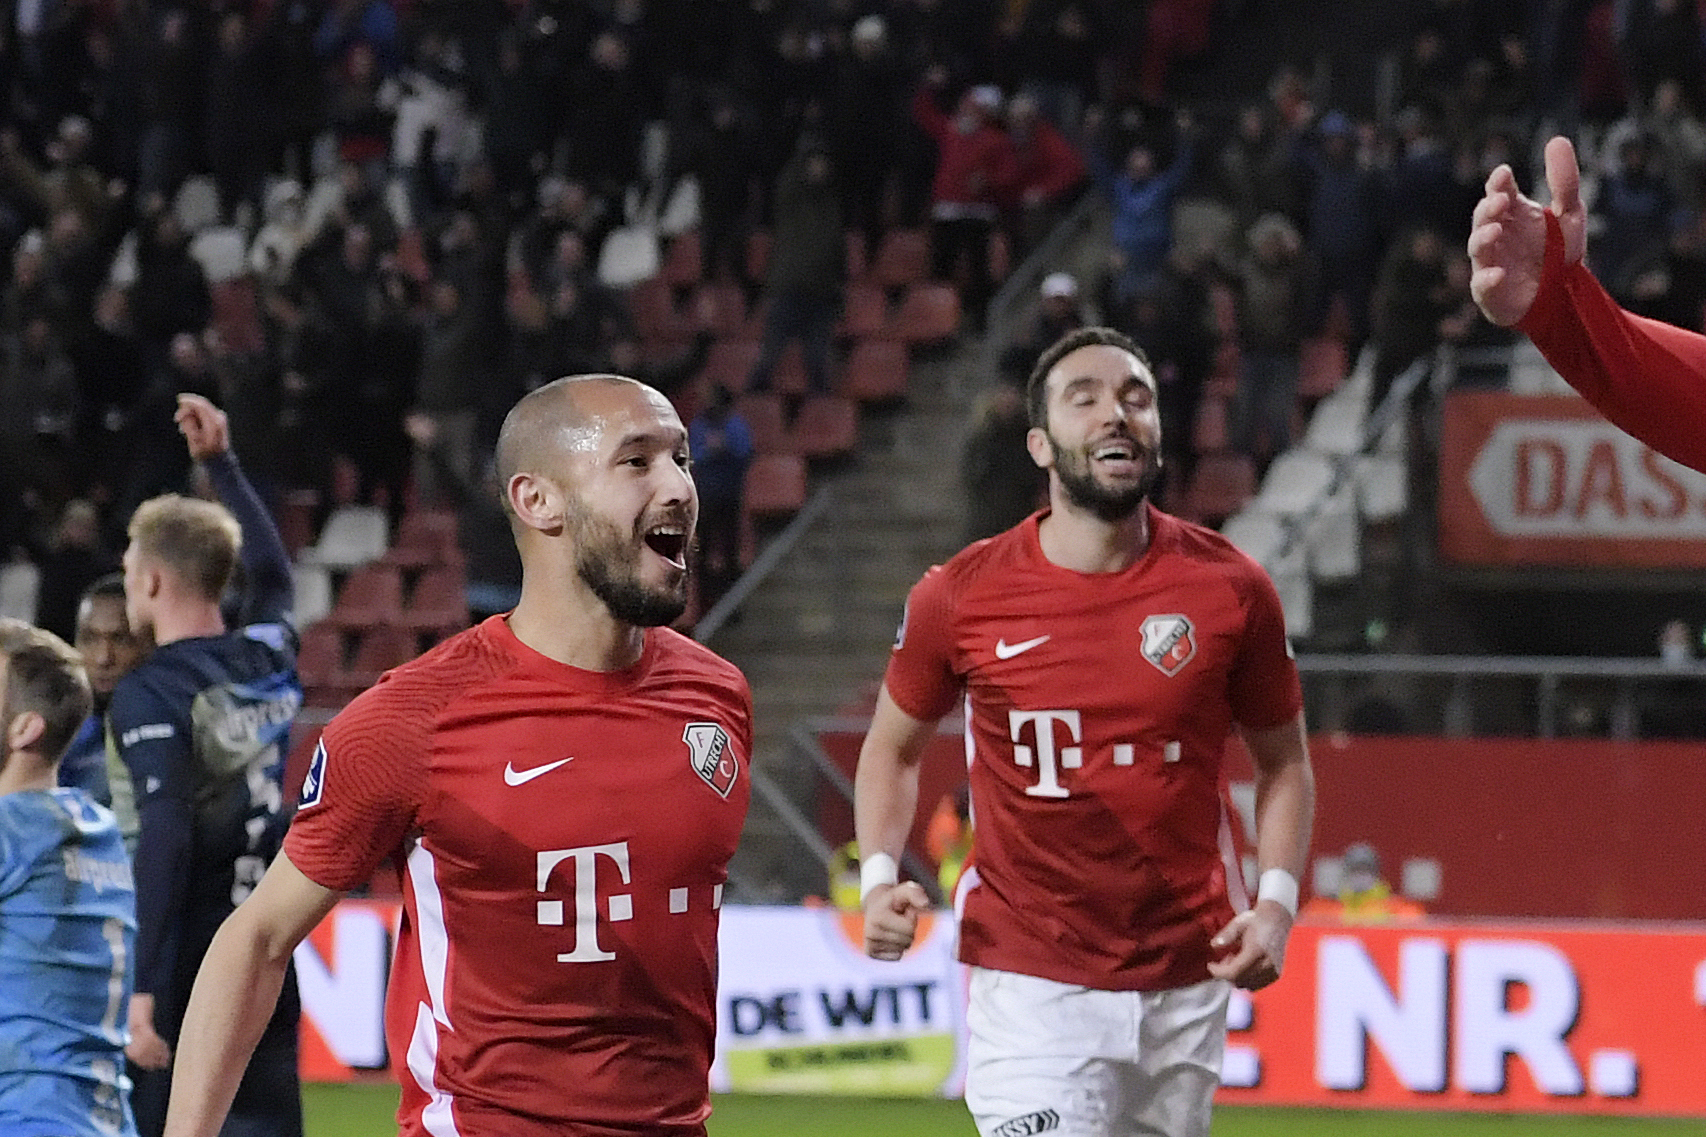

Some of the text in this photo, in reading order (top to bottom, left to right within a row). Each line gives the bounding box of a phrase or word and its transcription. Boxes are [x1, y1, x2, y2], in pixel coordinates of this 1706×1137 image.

[730, 979, 937, 1036] DE WIT
[1316, 935, 1637, 1096] NR.
